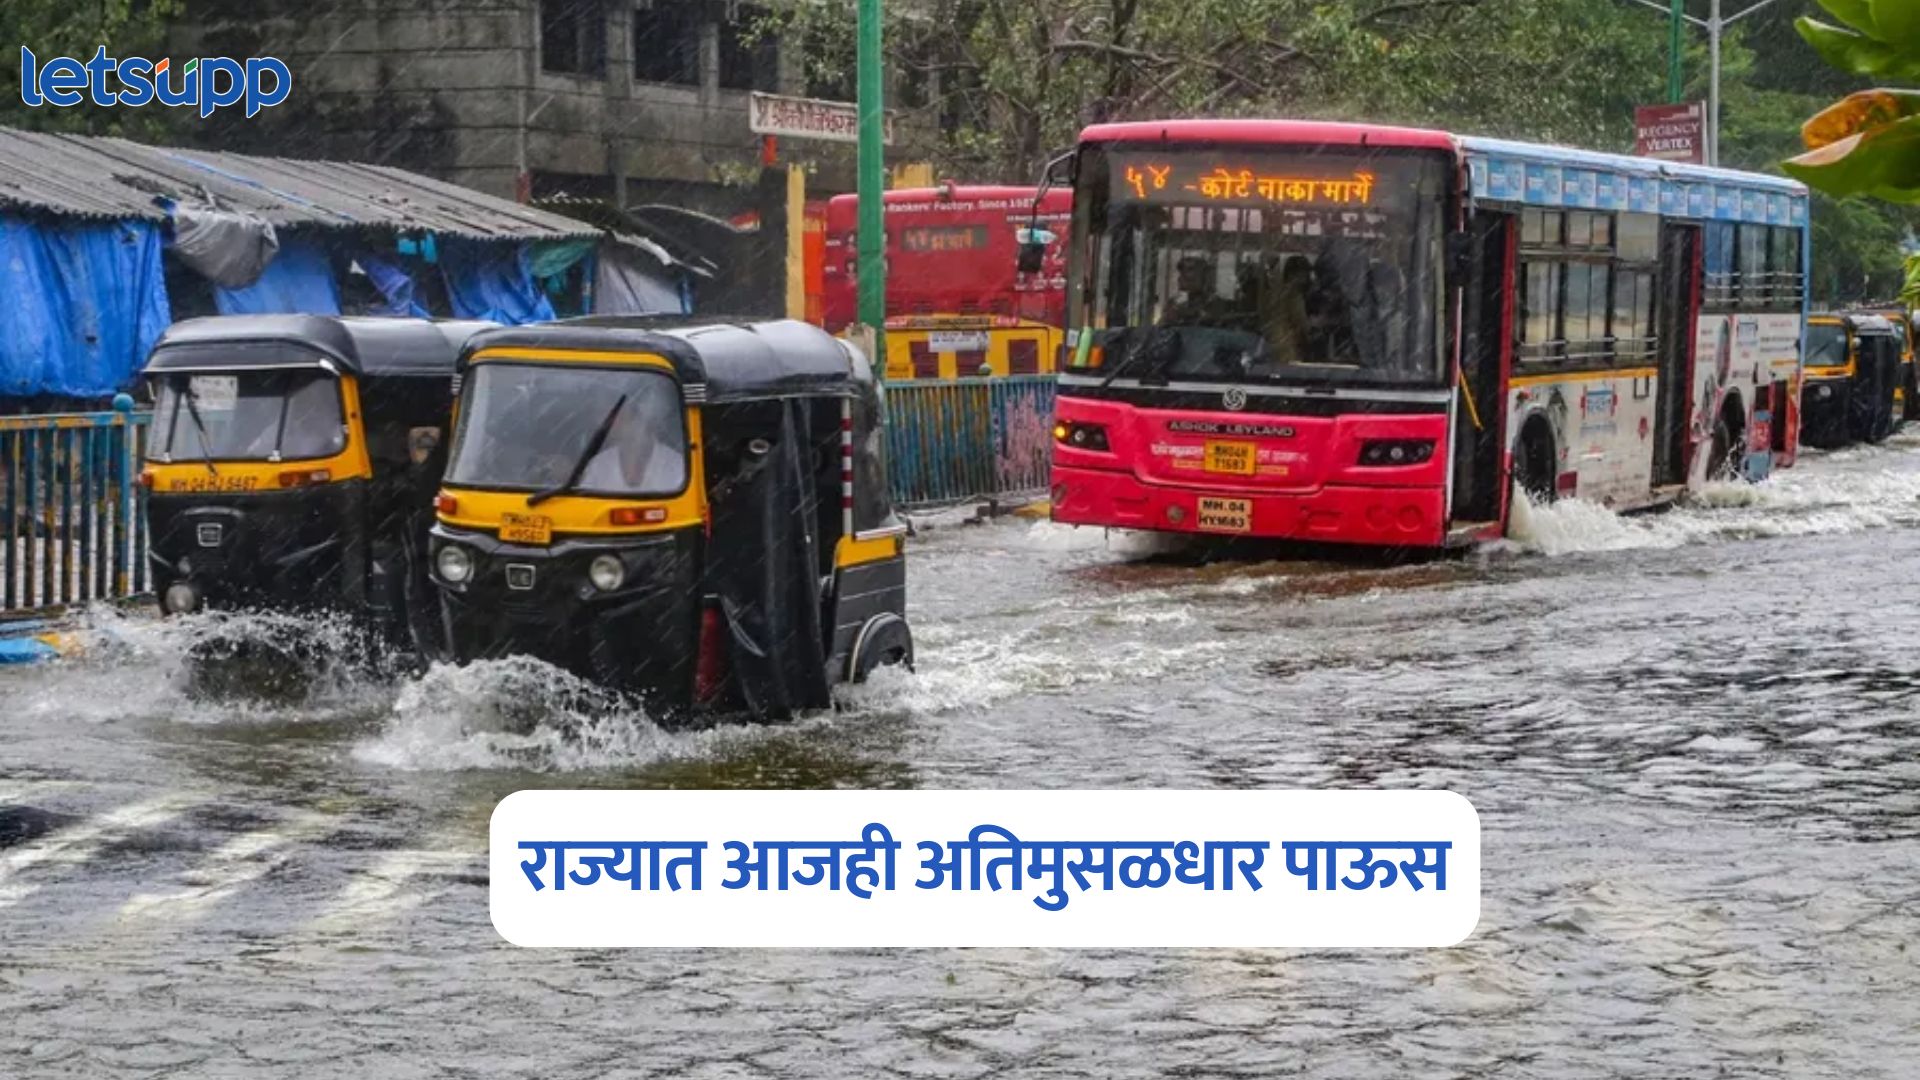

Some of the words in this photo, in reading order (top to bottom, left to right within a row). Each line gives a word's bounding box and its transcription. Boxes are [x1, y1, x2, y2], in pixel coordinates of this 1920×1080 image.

[1638, 122, 1700, 138] REGENCY
[1646, 138, 1692, 151] VERTEX
[1201, 167, 1254, 199] कोर्ट
[979, 198, 1007, 210] Since
[1169, 420, 1218, 434] ASHOK
[1225, 424, 1294, 437] LEYLAND
